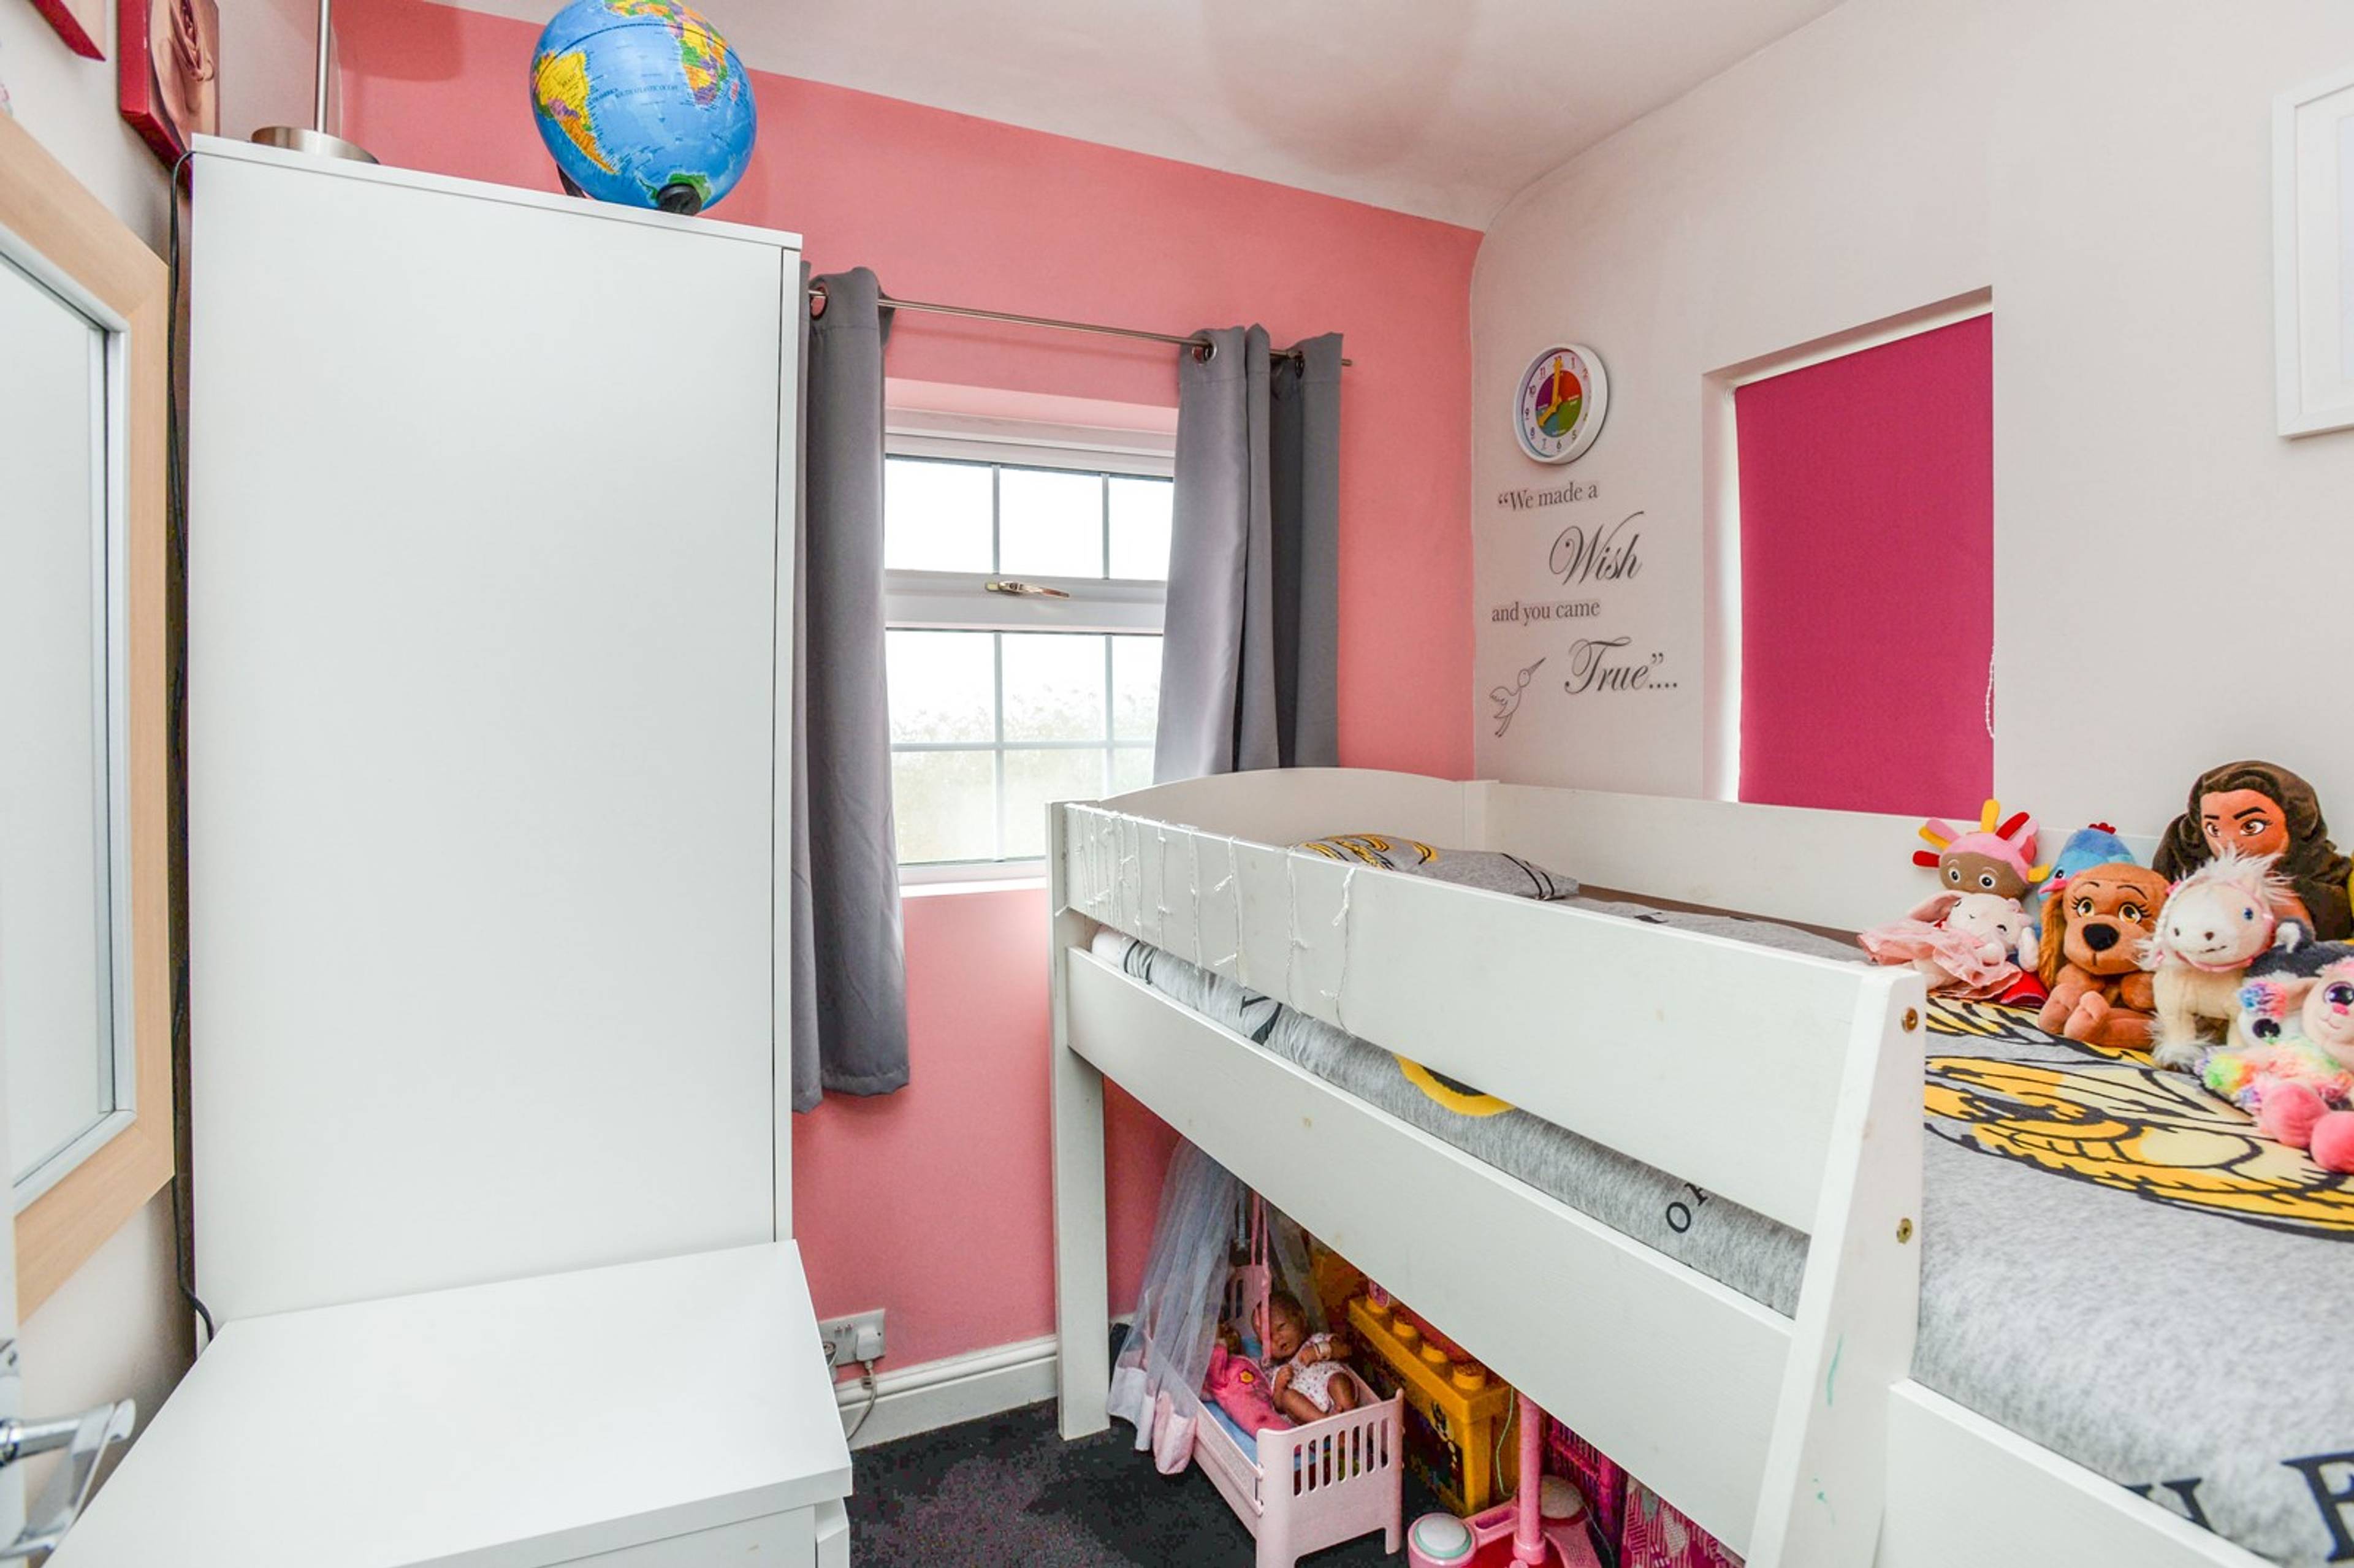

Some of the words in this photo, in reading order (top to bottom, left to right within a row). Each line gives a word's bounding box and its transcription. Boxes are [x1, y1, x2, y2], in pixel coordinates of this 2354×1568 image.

[1539, 481, 1583, 507] made
[1588, 484, 1598, 499] a
[1549, 511, 1644, 585] Wish
[1491, 601, 1519, 622] and
[1523, 604, 1551, 627] you
[1556, 598, 1601, 618] came
